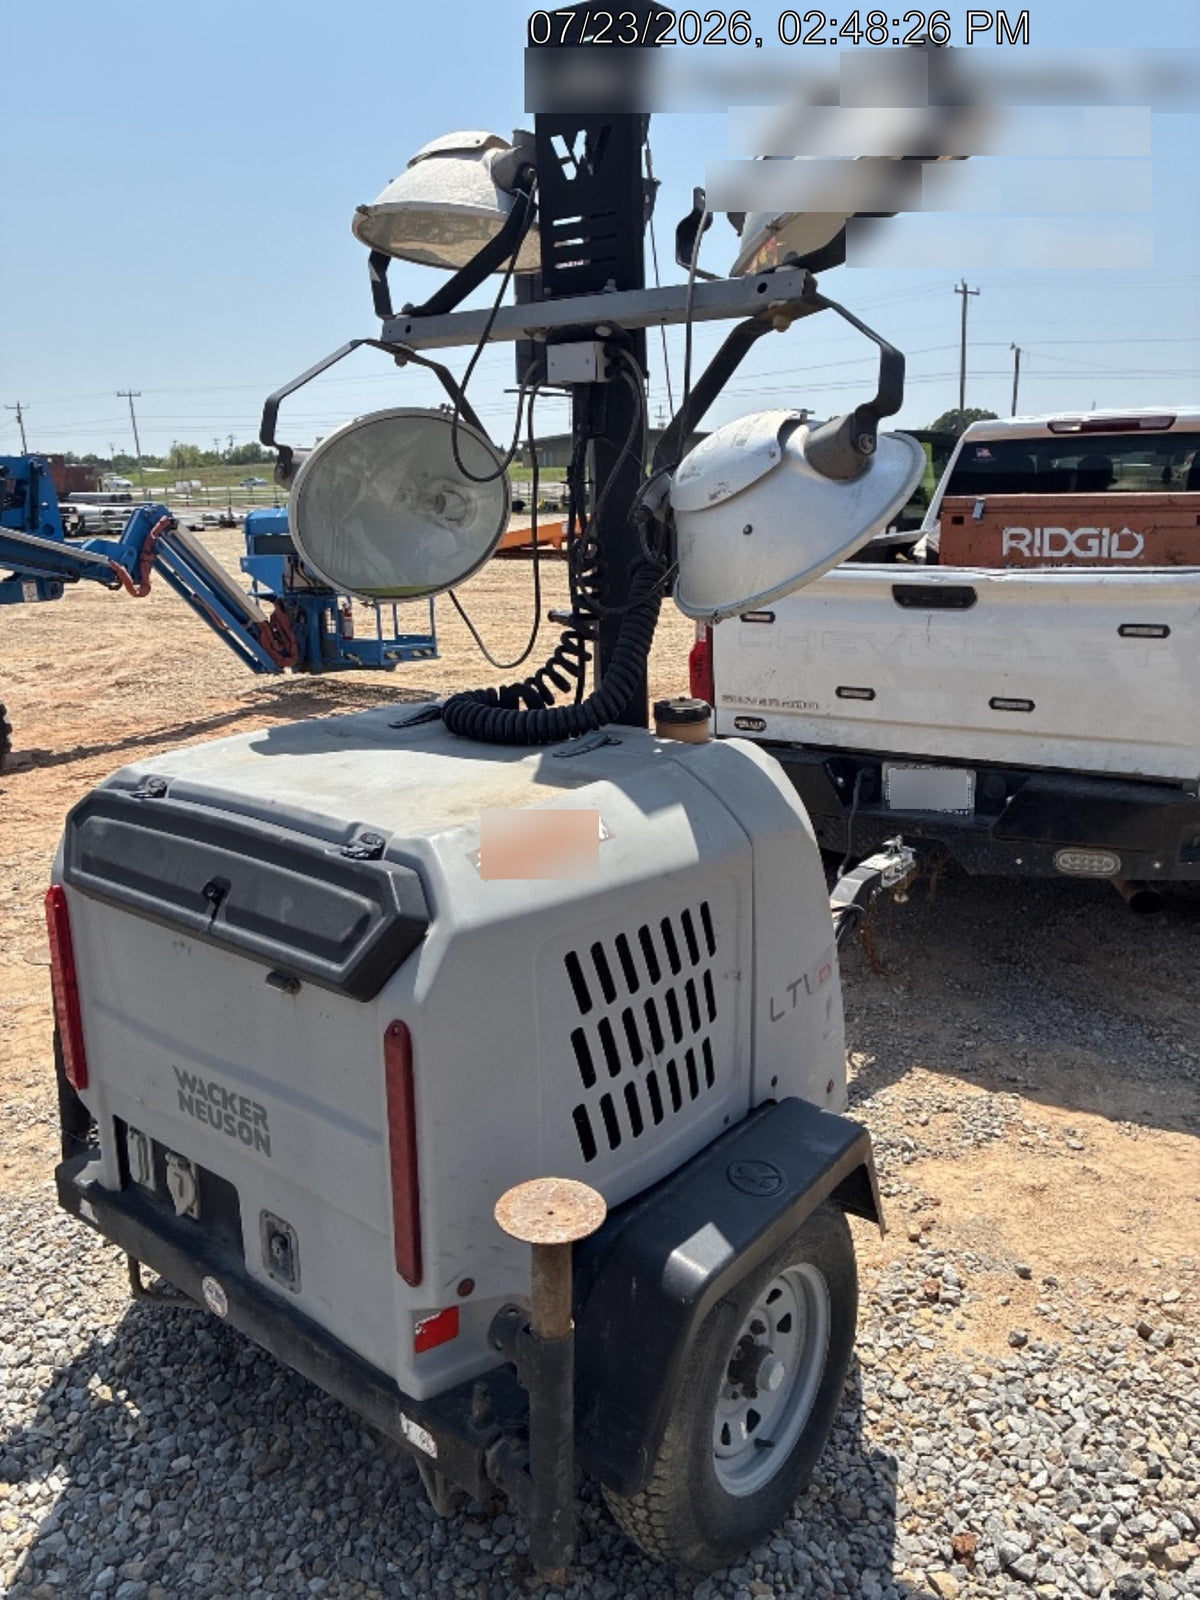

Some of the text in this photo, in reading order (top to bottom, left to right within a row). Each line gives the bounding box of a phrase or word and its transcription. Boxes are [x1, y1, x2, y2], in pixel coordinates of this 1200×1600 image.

[1002, 526, 1144, 559] RIDGID
[172, 1064, 270, 1133] WACKER
[177, 1089, 271, 1158] NEUSON
